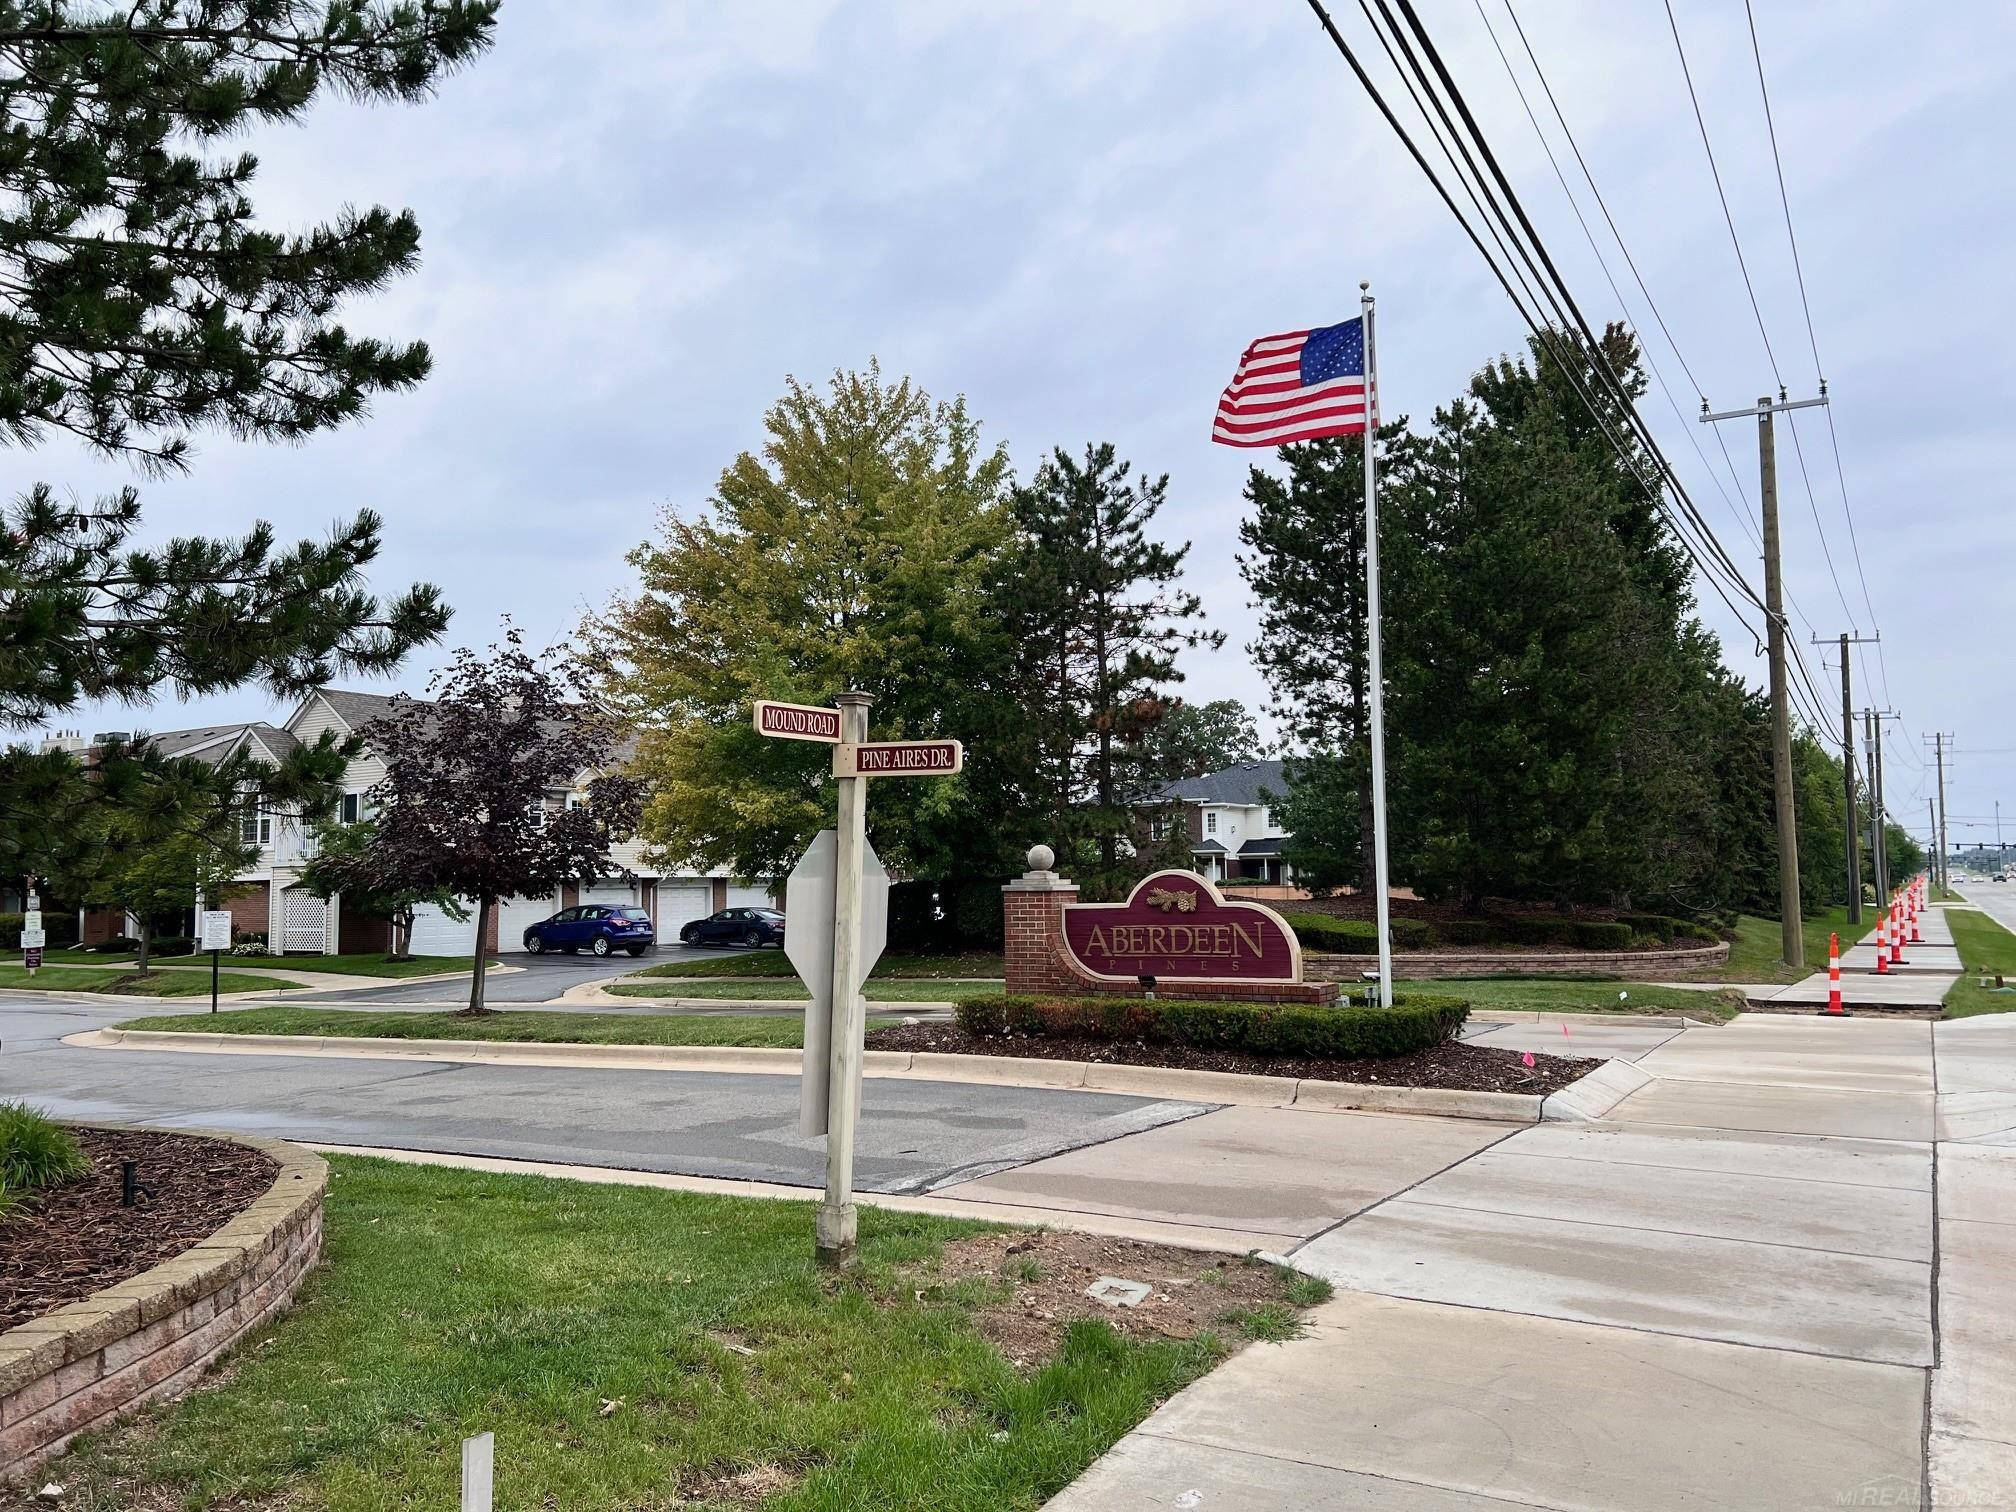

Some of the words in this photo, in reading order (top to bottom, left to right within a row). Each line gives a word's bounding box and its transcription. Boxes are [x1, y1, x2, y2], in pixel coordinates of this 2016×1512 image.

[765, 708, 806, 732] MOUND
[807, 714, 835, 735] ROAD
[862, 750, 891, 769] PINE
[892, 749, 928, 768] AIRES
[931, 748, 951, 767] DR.
[1083, 921, 1265, 959] ABERDEEN
[1109, 960, 1239, 972] PINES
